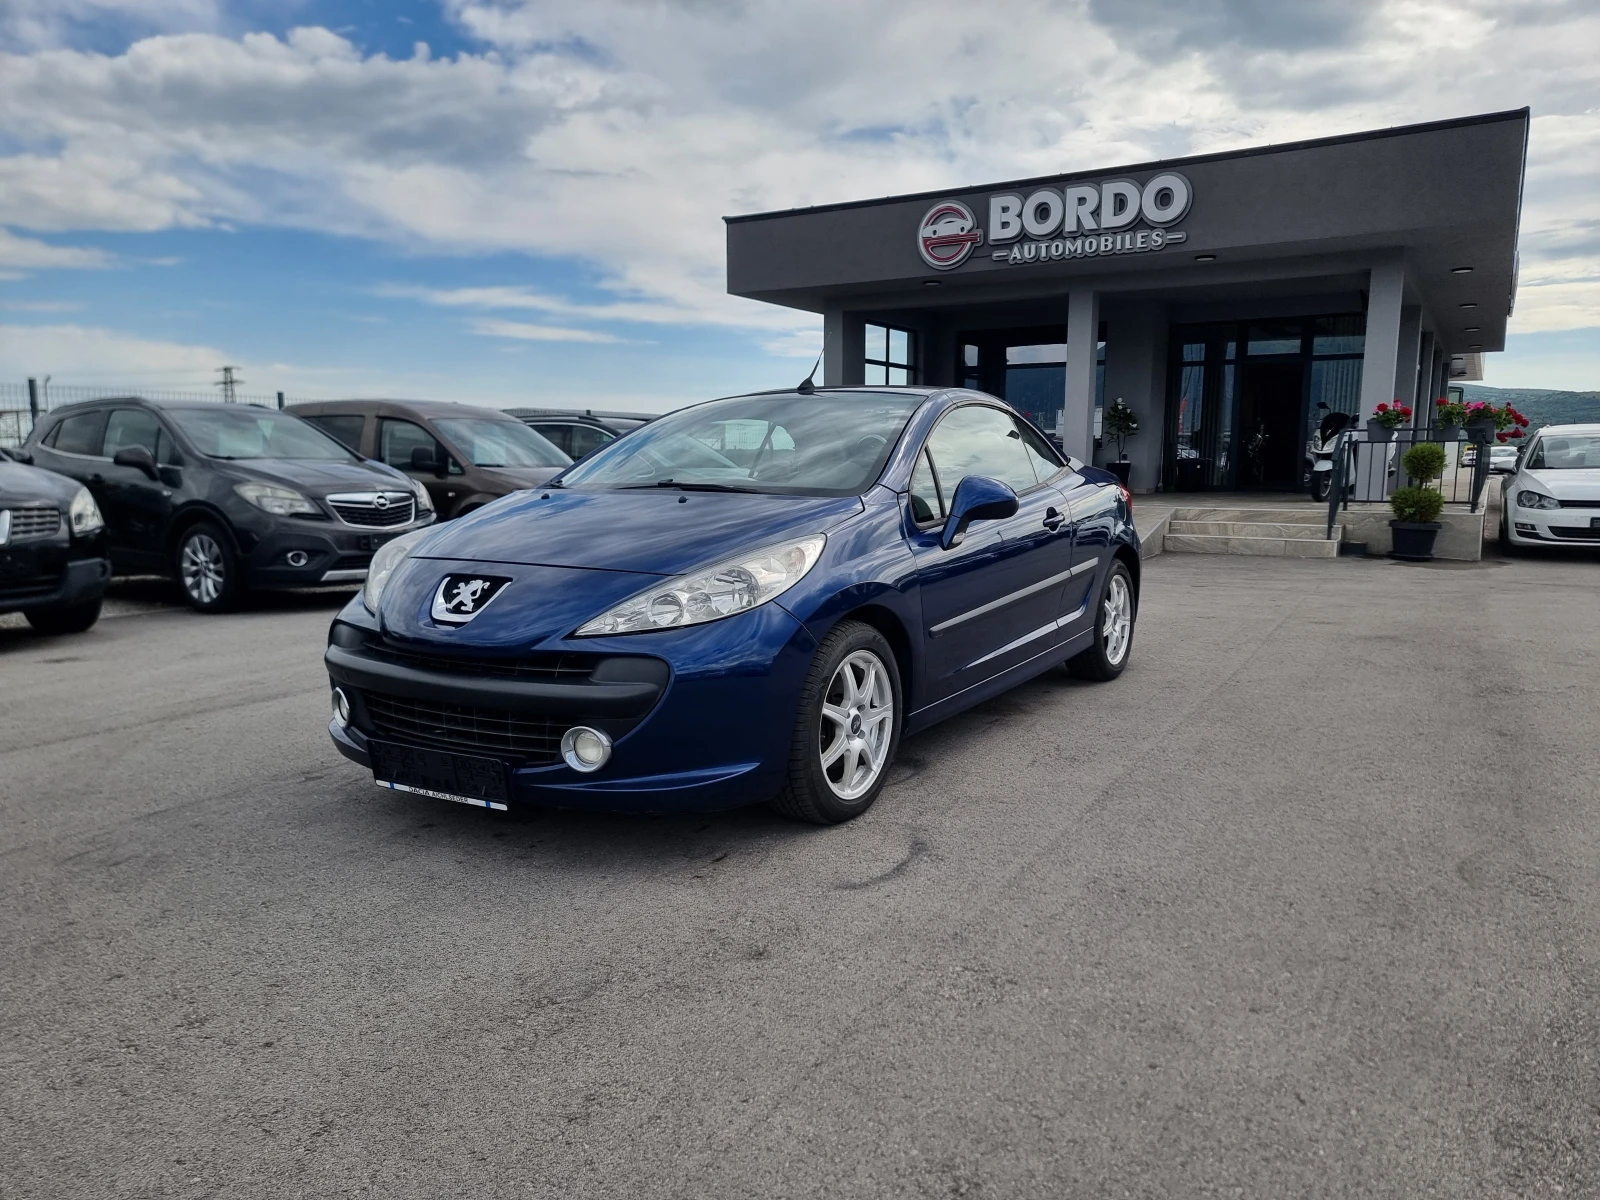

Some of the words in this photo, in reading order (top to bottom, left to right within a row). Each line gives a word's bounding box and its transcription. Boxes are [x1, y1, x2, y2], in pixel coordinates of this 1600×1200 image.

[989, 175, 1189, 240] BORDO
[1010, 231, 1163, 260] AUTOMOBILES
[408, 786, 431, 797] DACIA
